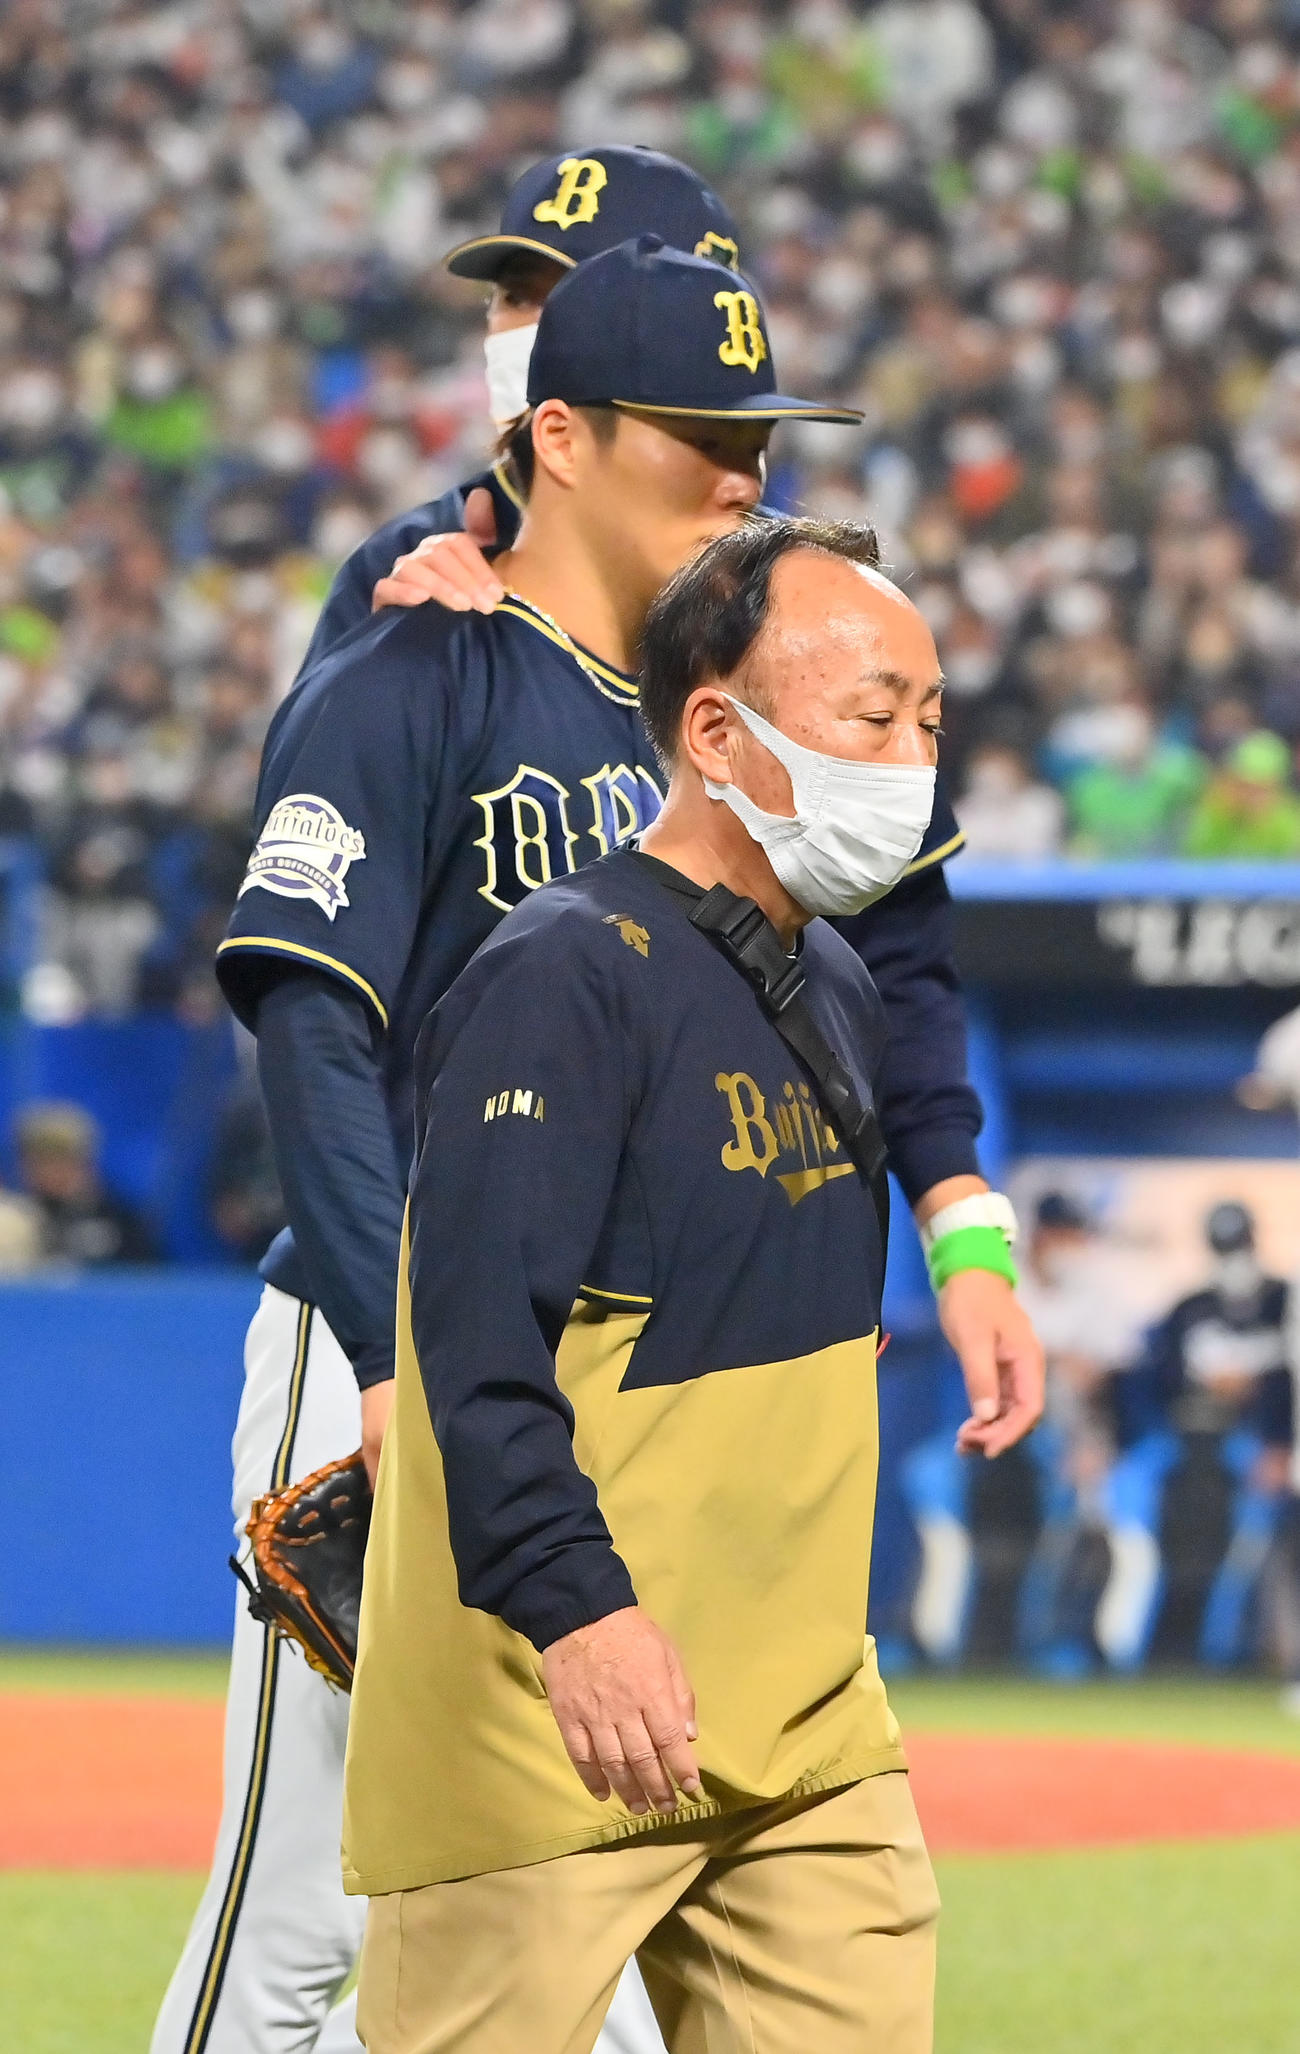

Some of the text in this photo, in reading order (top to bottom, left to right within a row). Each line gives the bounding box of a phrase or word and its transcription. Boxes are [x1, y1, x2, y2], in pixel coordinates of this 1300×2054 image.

[533, 158, 608, 231] B
[714, 291, 767, 374] B
[483, 1088, 545, 1123] NOMA
